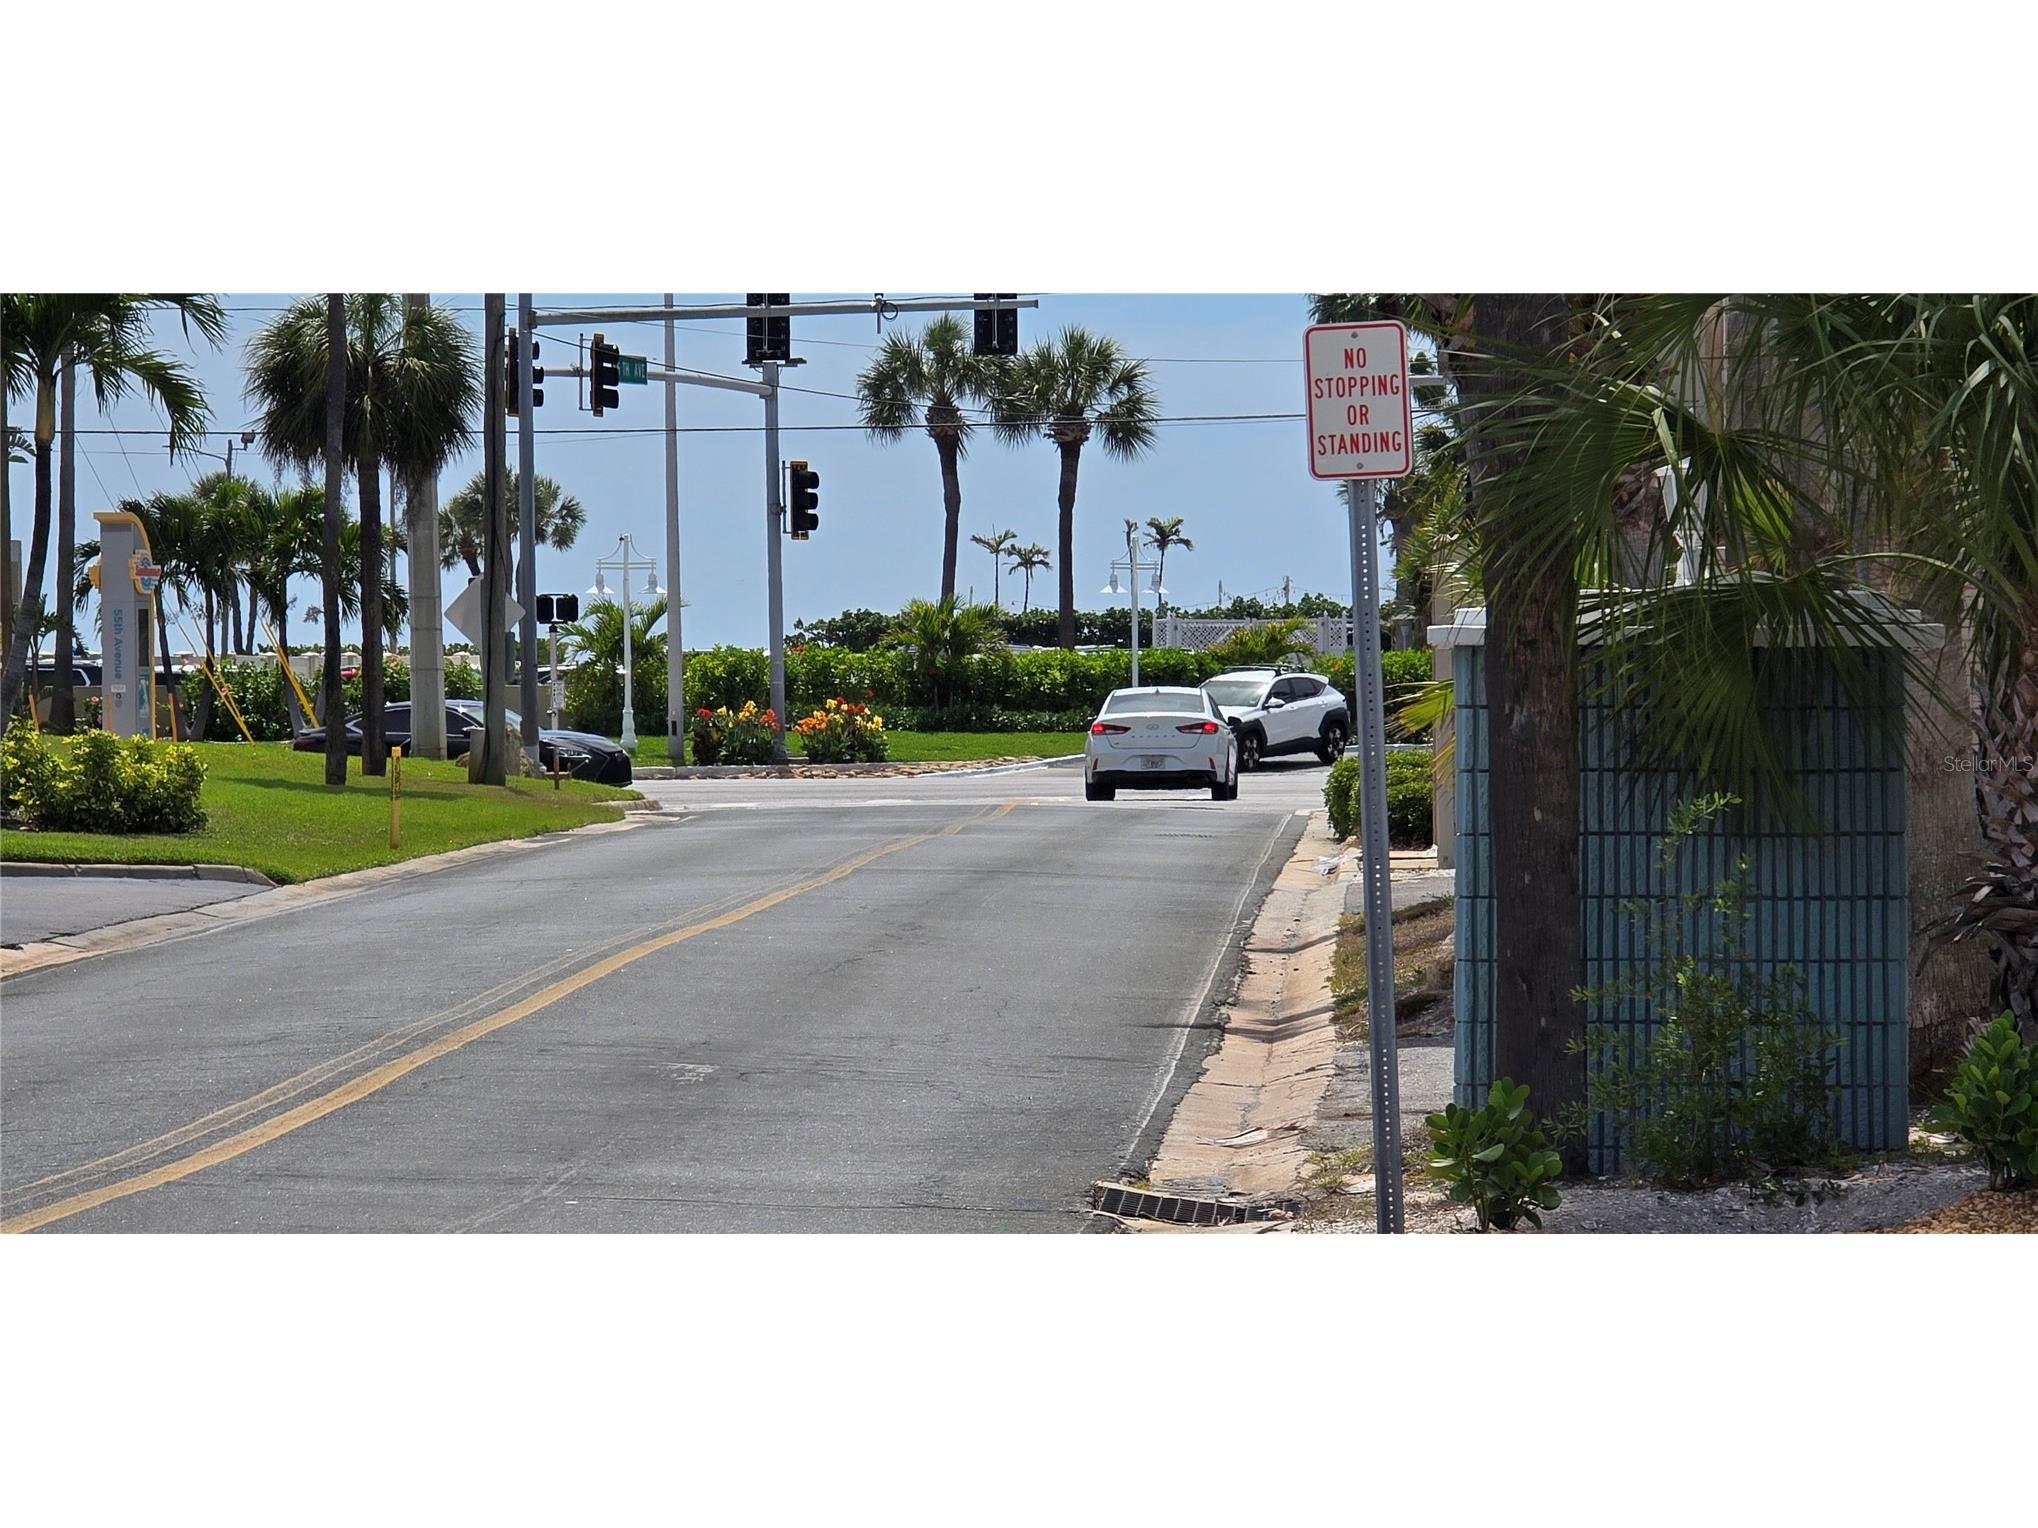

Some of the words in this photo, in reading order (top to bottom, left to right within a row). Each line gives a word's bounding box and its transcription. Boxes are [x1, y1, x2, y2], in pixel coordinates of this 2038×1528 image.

[634, 361, 646, 379] AVE
[1344, 347, 1367, 369] NO
[1314, 374, 1400, 399] STOPPING
[1347, 404, 1369, 426] OR
[1318, 431, 1402, 456] STANDING
[113, 608, 124, 635] 55th
[113, 637, 123, 680] Avenue
